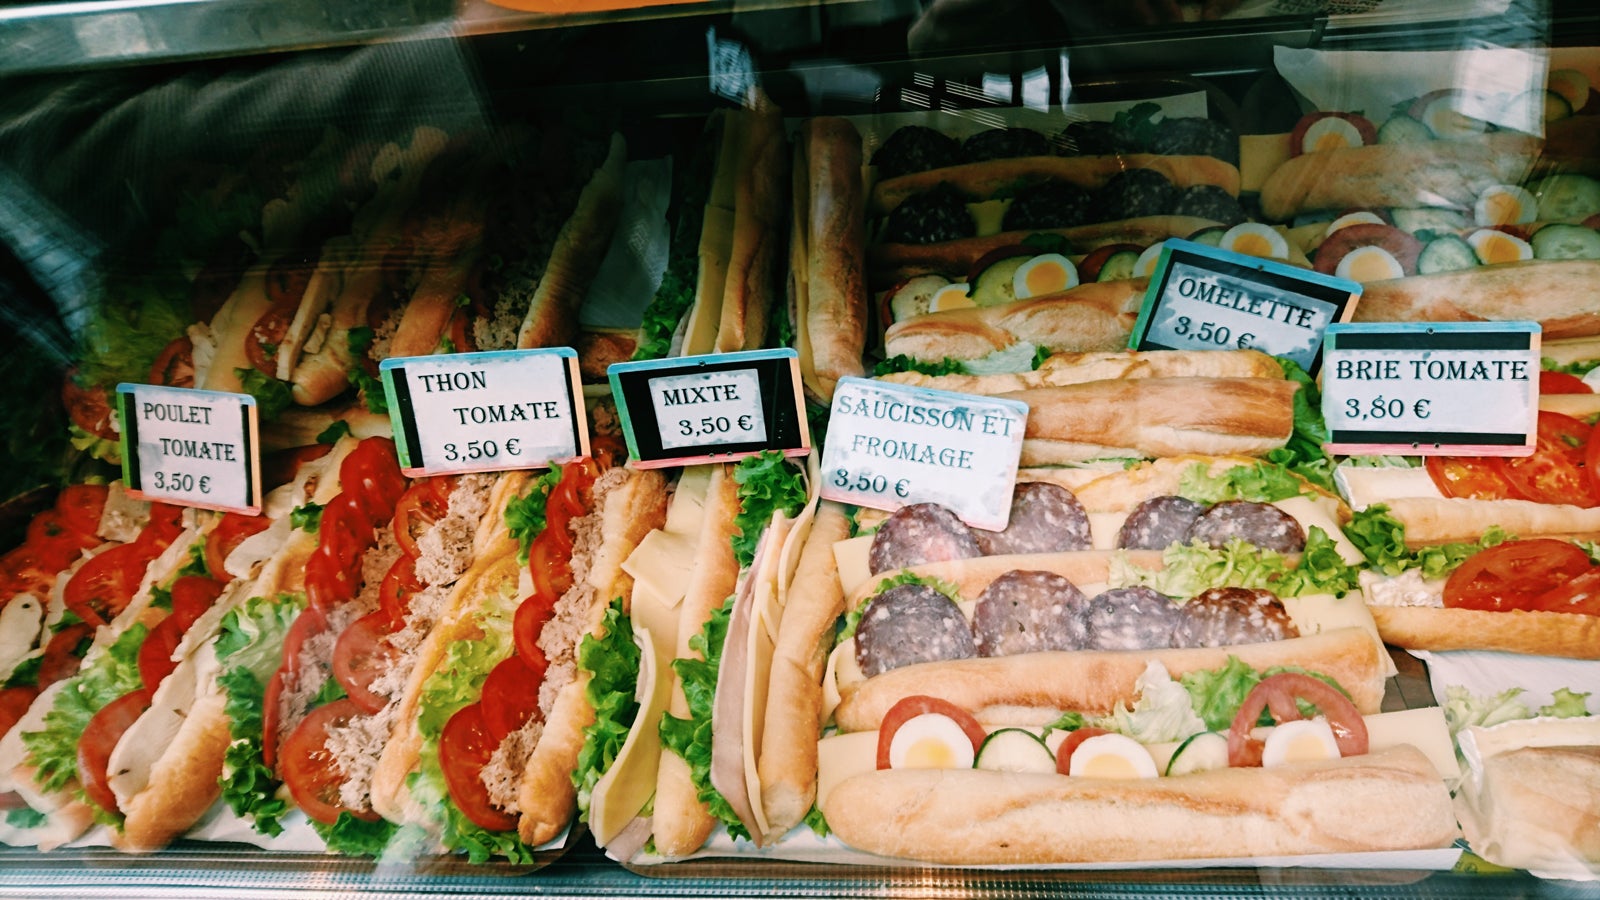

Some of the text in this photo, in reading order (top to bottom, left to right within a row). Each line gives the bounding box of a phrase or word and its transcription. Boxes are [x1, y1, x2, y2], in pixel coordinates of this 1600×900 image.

[1178, 278, 1317, 330] OMELETTE
[1174, 316, 1256, 350] 3,50 €
[418, 370, 487, 393] THON
[1336, 360, 1529, 381] BRIE TOMATE
[662, 384, 740, 406] MIXTE
[143, 401, 212, 425] POULET
[453, 401, 560, 426] TOMATE
[838, 395, 1017, 438] SAUCISSON ET
[1345, 395, 1432, 420] 3,80 €
[679, 414, 753, 438] 3,50 €
[159, 438, 236, 461] TOMATE
[444, 438, 522, 462] 3,50 €
[851, 434, 975, 470] FROMAGE
[154, 471, 211, 494] 3,50 €
[834, 468, 911, 498] 3,50 €
